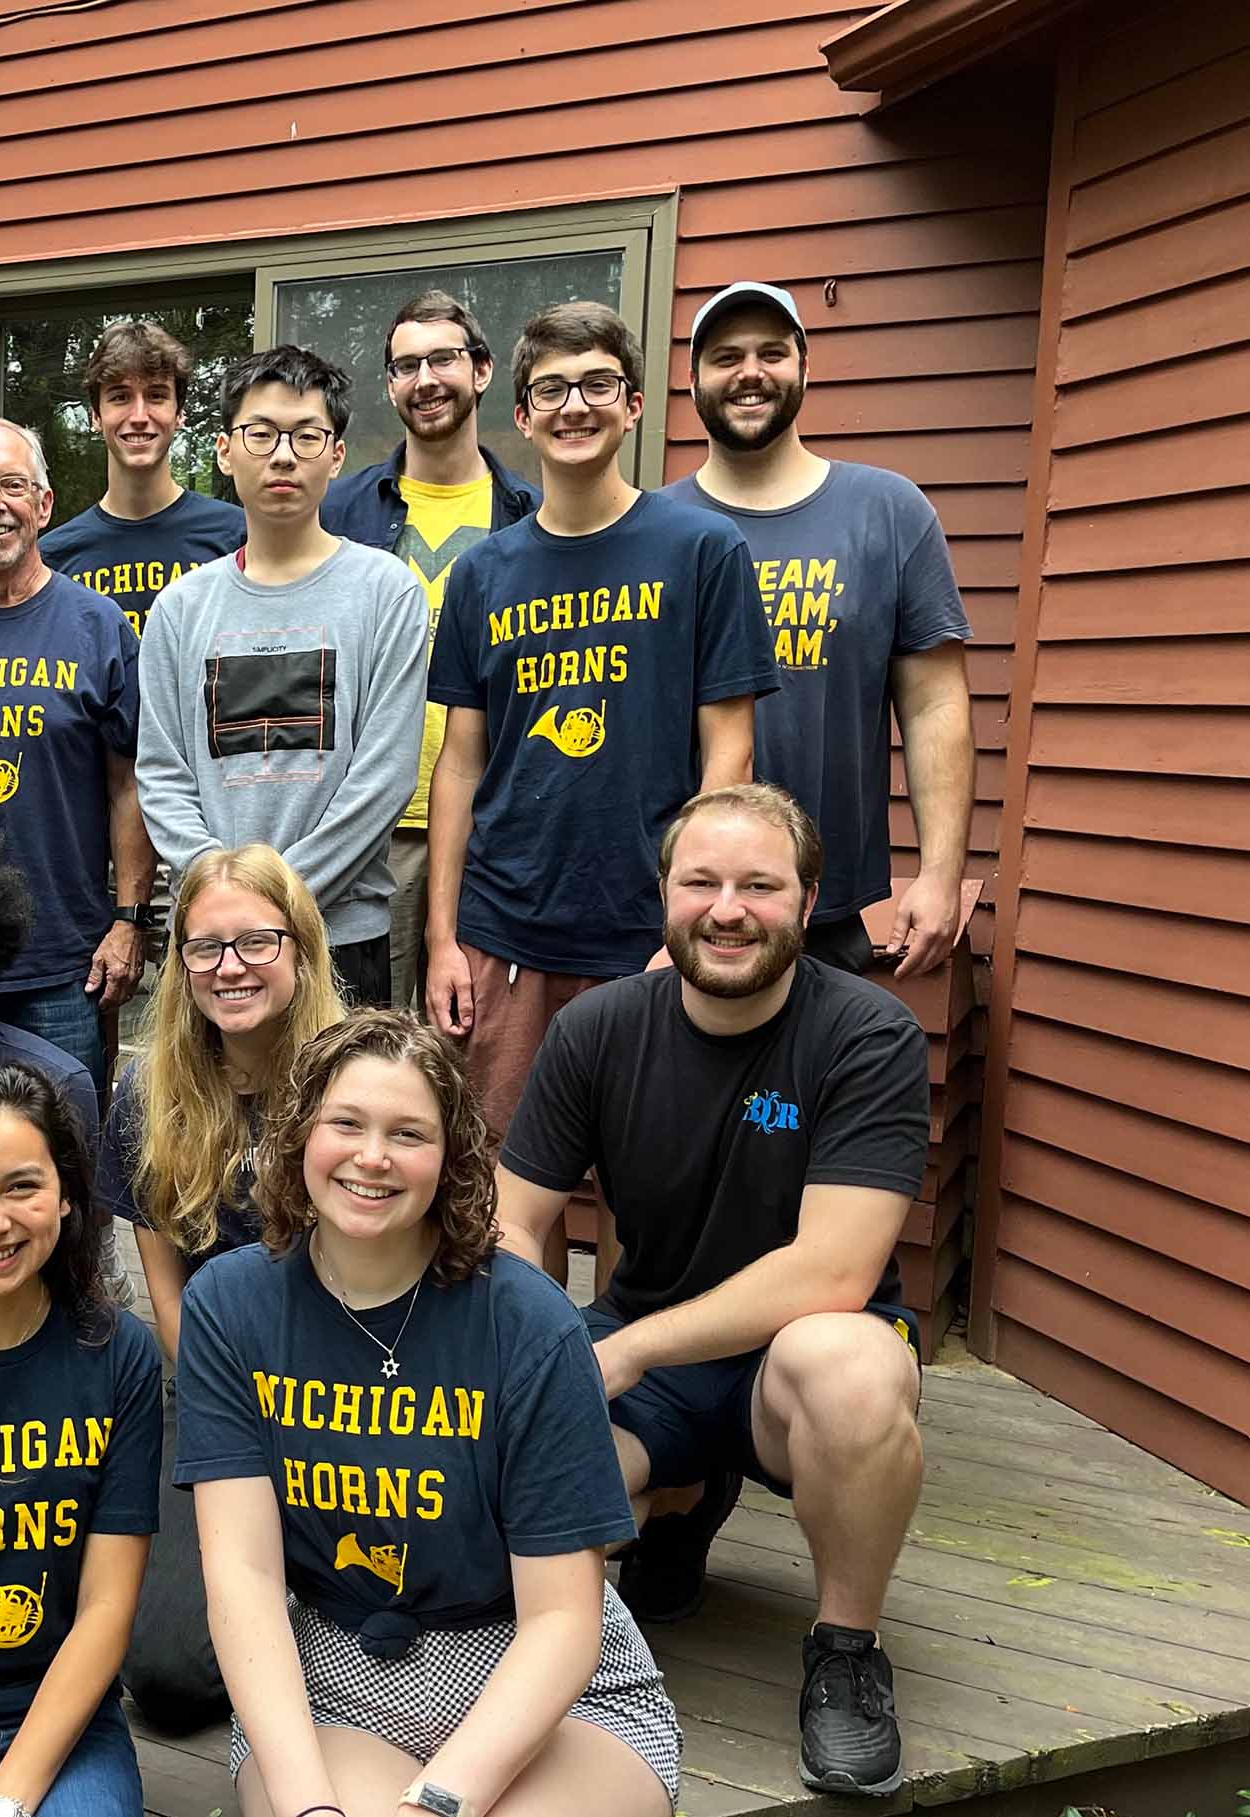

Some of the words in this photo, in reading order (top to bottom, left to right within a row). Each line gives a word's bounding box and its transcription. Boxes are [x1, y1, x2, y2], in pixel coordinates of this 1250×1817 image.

[72, 561, 202, 596] ICHIGA
[753, 559, 844, 596] EAM,
[488, 581, 664, 646] MICHIGAN
[516, 645, 628, 694] HORNS
[252, 1371, 485, 1440] MICHIGAN
[283, 1457, 446, 1520] HORNS
